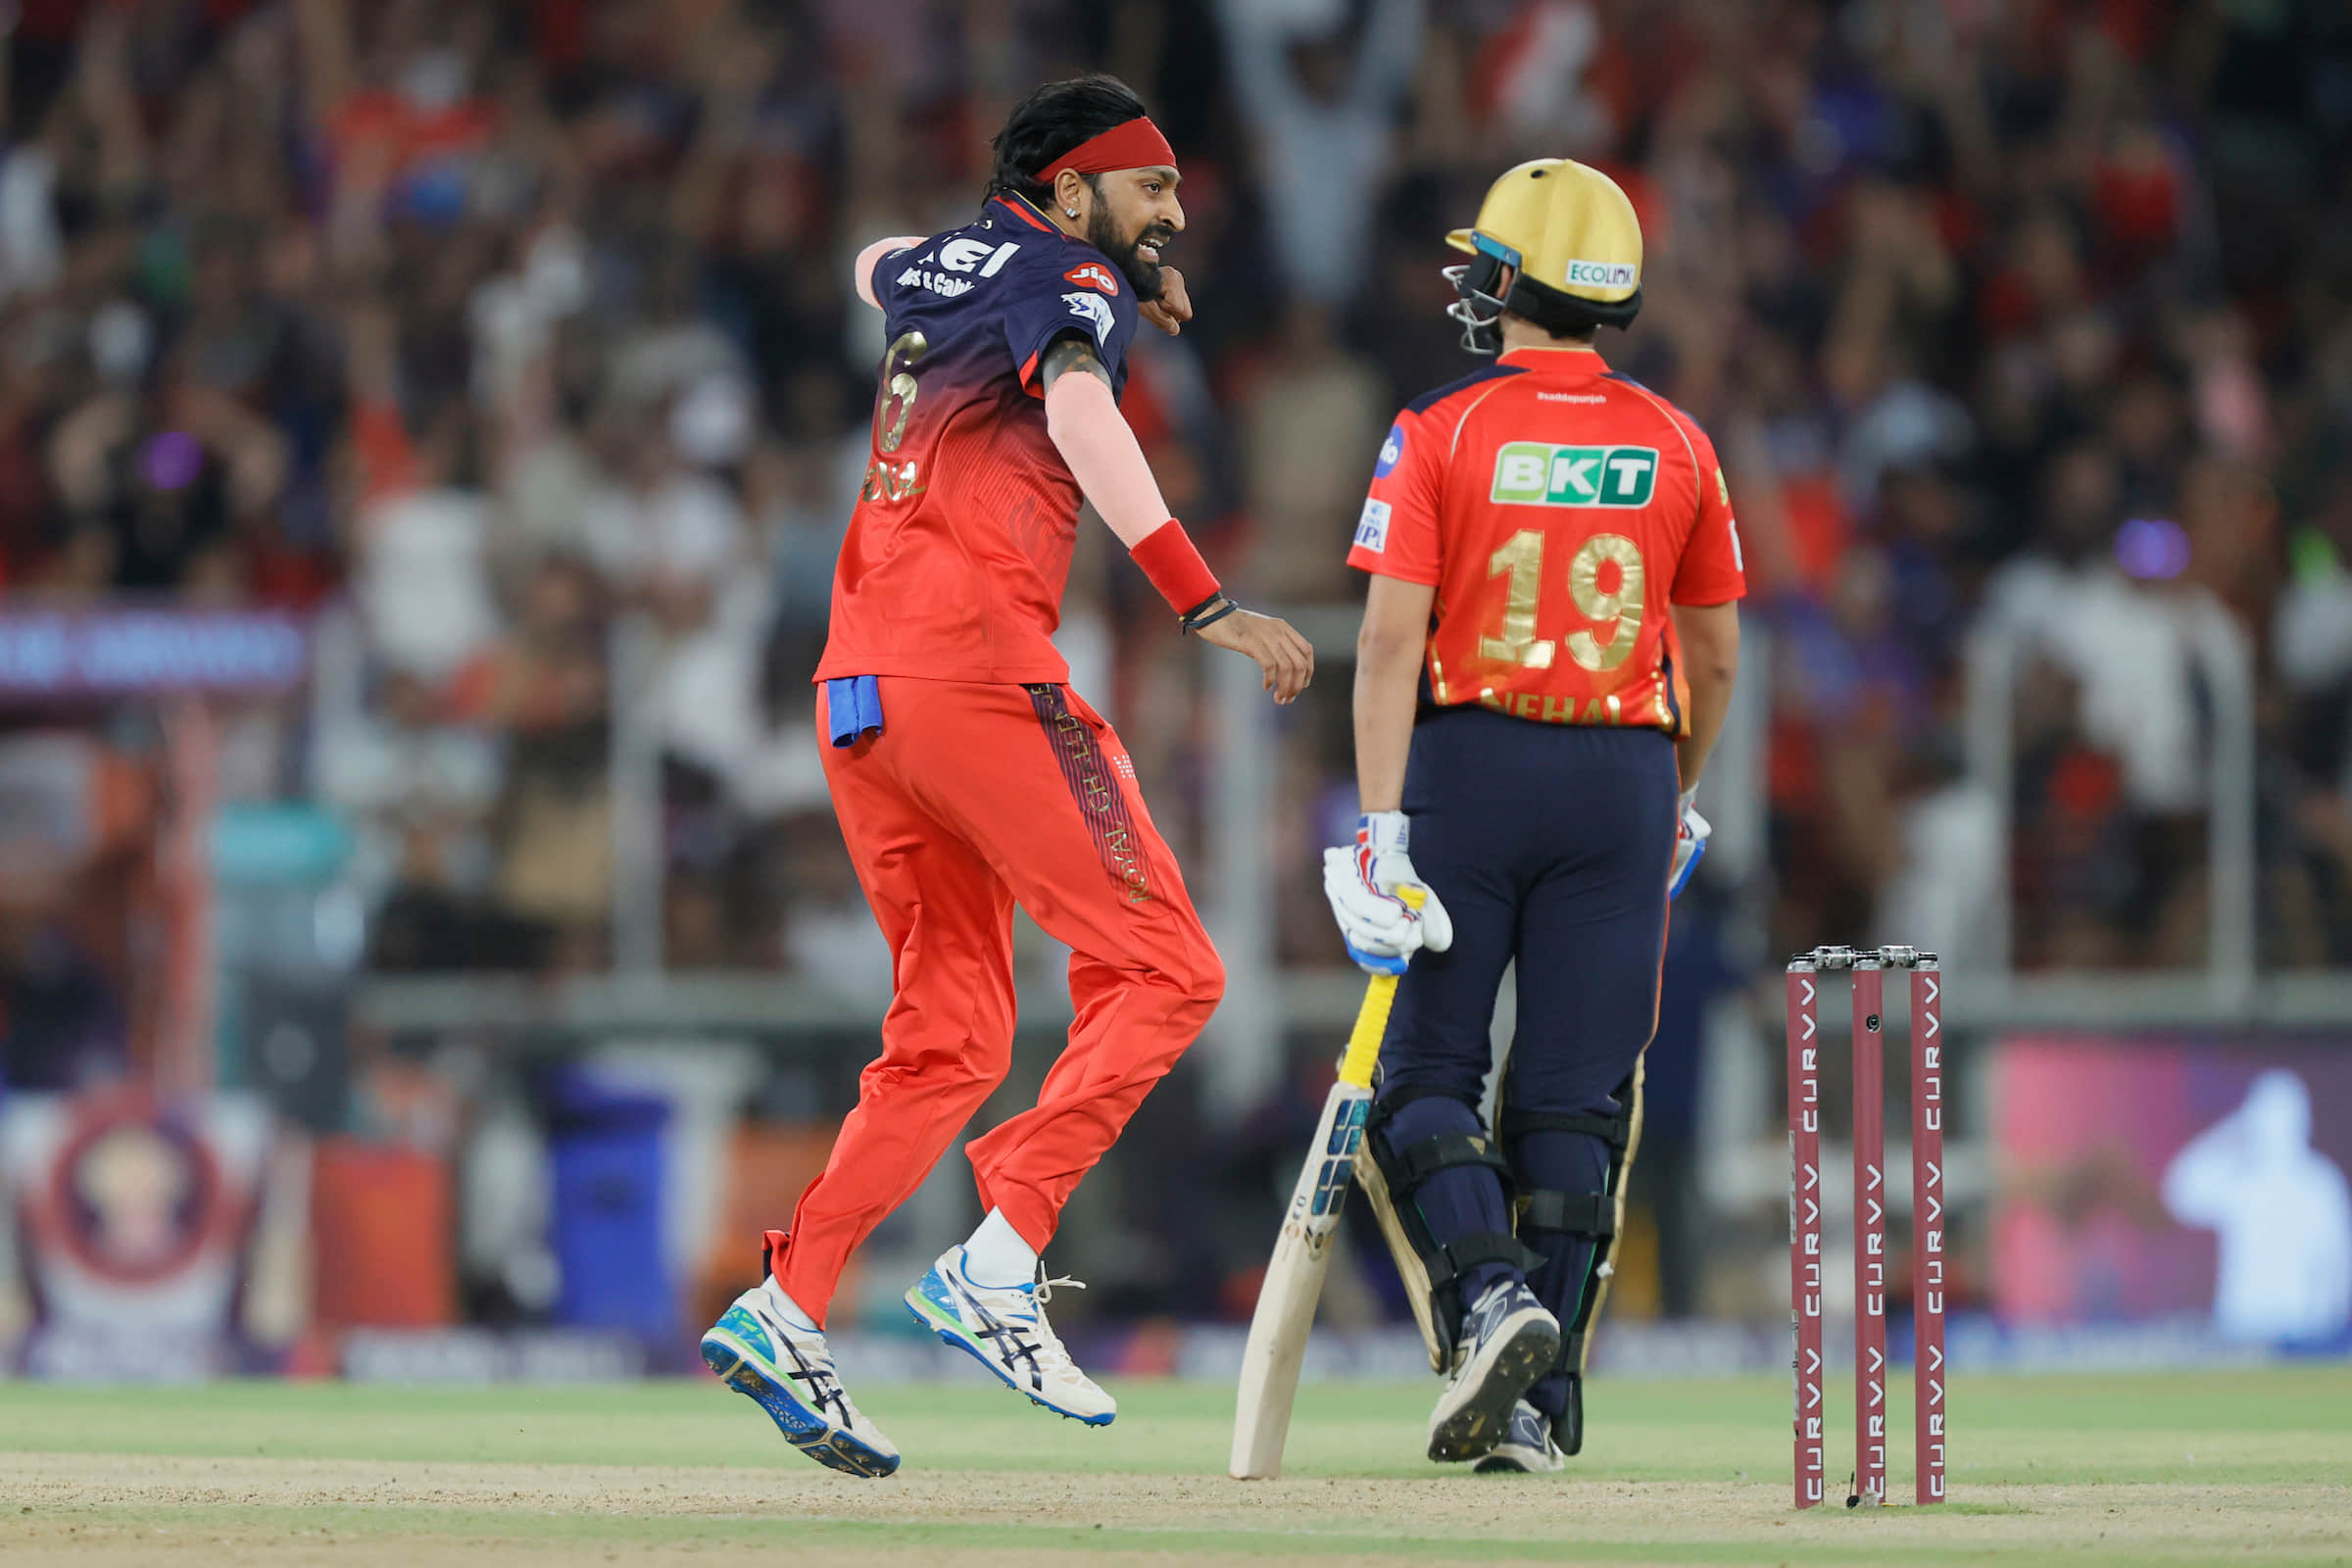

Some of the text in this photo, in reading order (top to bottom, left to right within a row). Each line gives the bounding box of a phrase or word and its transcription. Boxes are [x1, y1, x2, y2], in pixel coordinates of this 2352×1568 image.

[1071, 266, 1115, 291] Jio
[1498, 455, 1653, 496] BKT
[1479, 528, 1644, 672] 19
[1104, 820, 1152, 905] ROYAL
[1801, 978, 1818, 1133] CURVV
[1925, 977, 1940, 1131] CURVV
[1804, 1163, 1820, 1317] CURVV
[1867, 1163, 1884, 1316] CURVV
[1927, 1161, 1942, 1314] CURVV
[1807, 1348, 1822, 1500] CURVV
[1869, 1346, 1885, 1500] CURVV
[1929, 1345, 1945, 1497] CURVV
